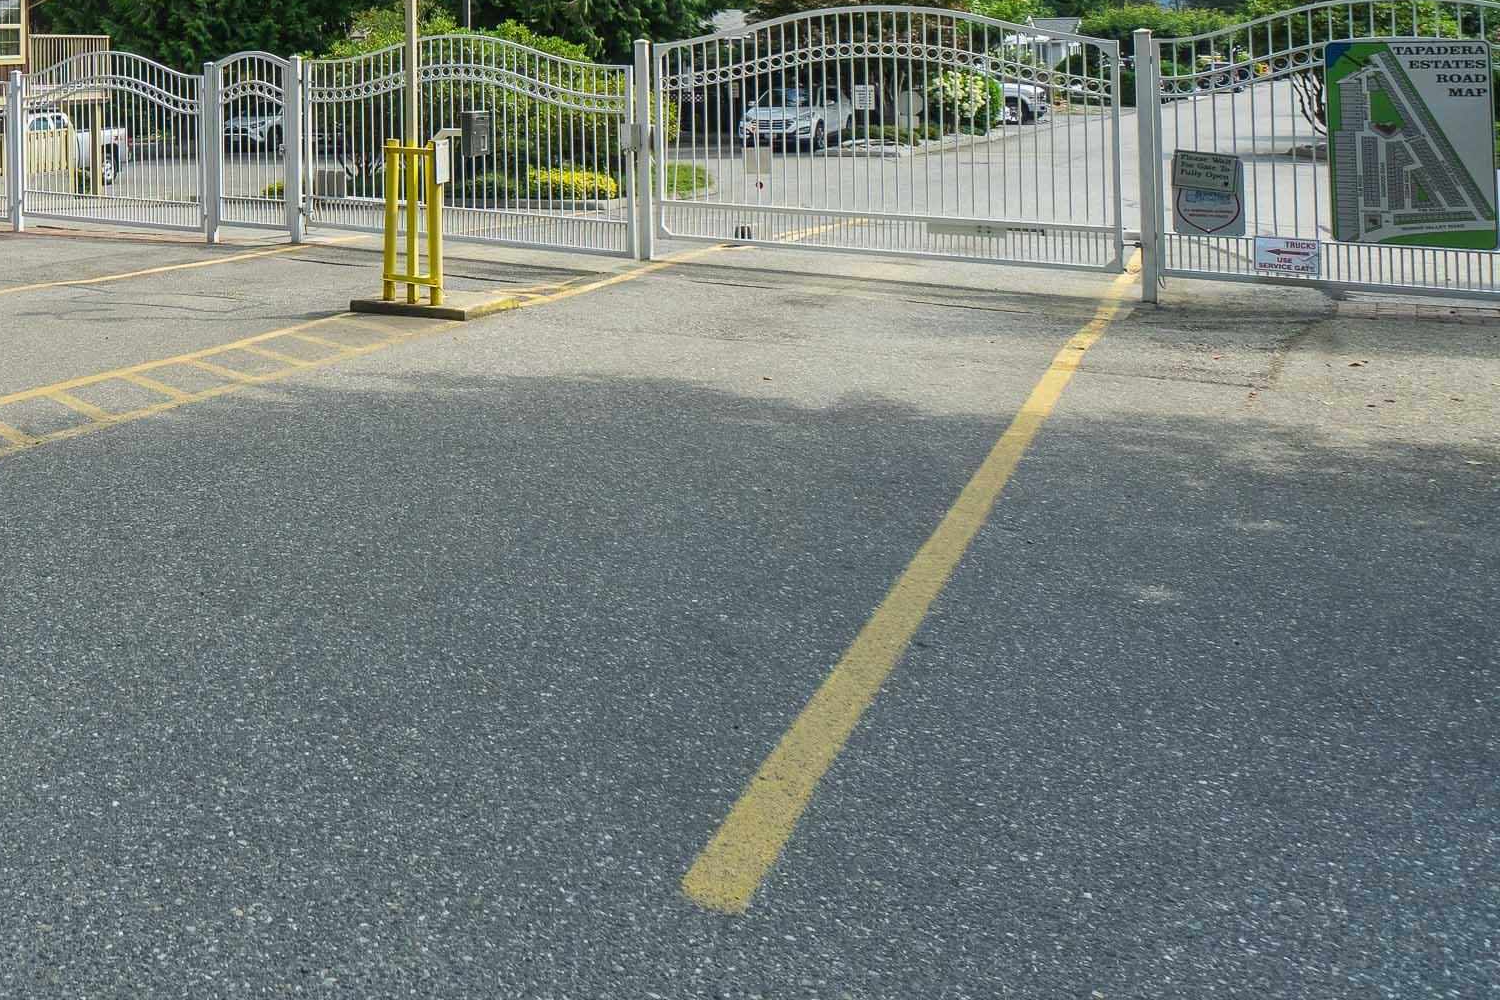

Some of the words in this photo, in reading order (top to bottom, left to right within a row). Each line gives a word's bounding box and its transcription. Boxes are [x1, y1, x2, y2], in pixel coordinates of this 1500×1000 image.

[1392, 46, 1485, 56] TAPADERA
[1409, 60, 1486, 69] ESTATES
[1436, 73, 1487, 83] ROAD
[1448, 87, 1488, 97] MAP
[1285, 241, 1317, 249] TRUCKS
[1258, 262, 1292, 271] SERVICE
